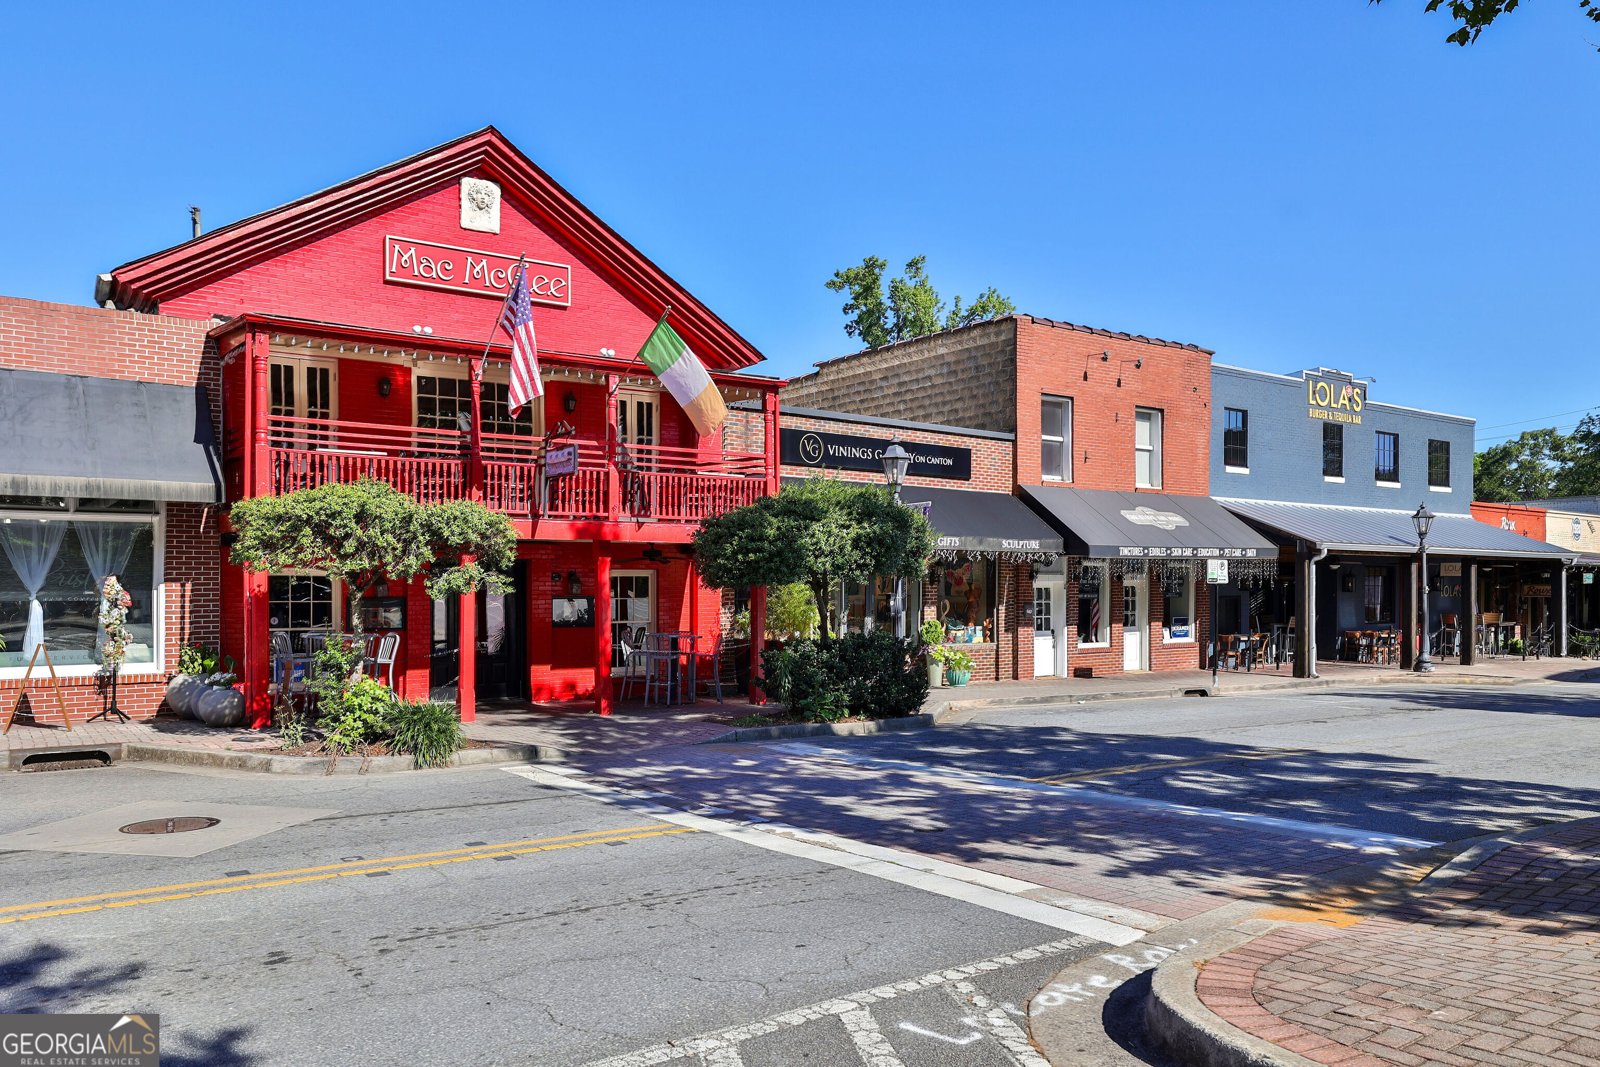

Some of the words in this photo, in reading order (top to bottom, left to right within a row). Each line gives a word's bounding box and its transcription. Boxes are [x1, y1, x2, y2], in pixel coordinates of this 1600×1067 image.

[390, 244, 454, 281] Mac
[1309, 380, 1362, 412] LOLA'S
[803, 439, 819, 457] VG
[827, 444, 872, 460] VININGS
[916, 455, 926, 464] ON
[927, 456, 953, 466] CANTON
[938, 537, 959, 547] GIFTS
[1002, 540, 1040, 549] SCULPTURE
[1119, 546, 1143, 556] TINCTURES
[1149, 547, 1166, 556] EDIBLES
[1171, 548, 1182, 556] SKIN
[1183, 548, 1193, 557] CARE
[1197, 548, 1220, 557] EDUCATION
[1232, 548, 1242, 557] CARE
[1246, 548, 1257, 557] BATH
